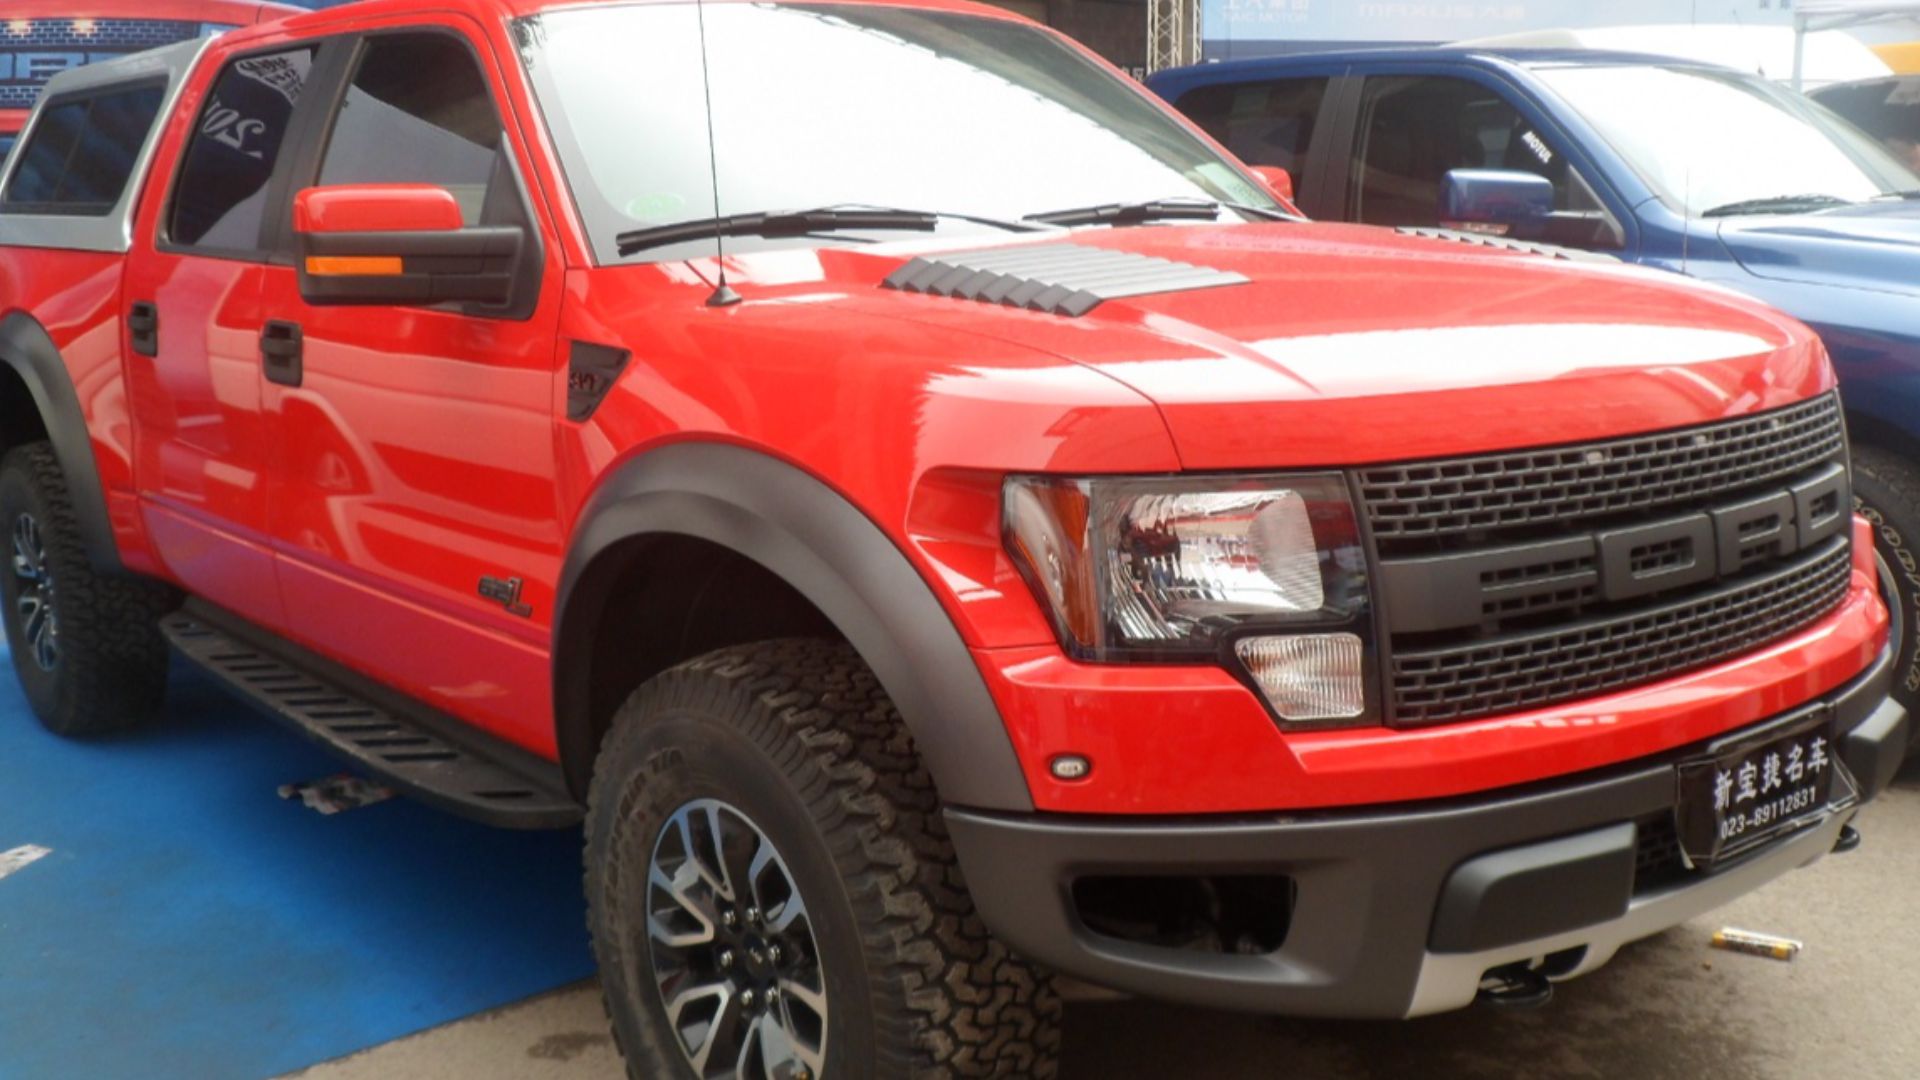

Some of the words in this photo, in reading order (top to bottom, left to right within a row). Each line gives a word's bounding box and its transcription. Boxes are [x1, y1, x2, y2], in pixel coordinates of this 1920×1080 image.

[1522, 130, 1552, 163] MOTUL
[1380, 463, 1846, 634] FORD
[1720, 786, 1817, 839] 023-89112831
